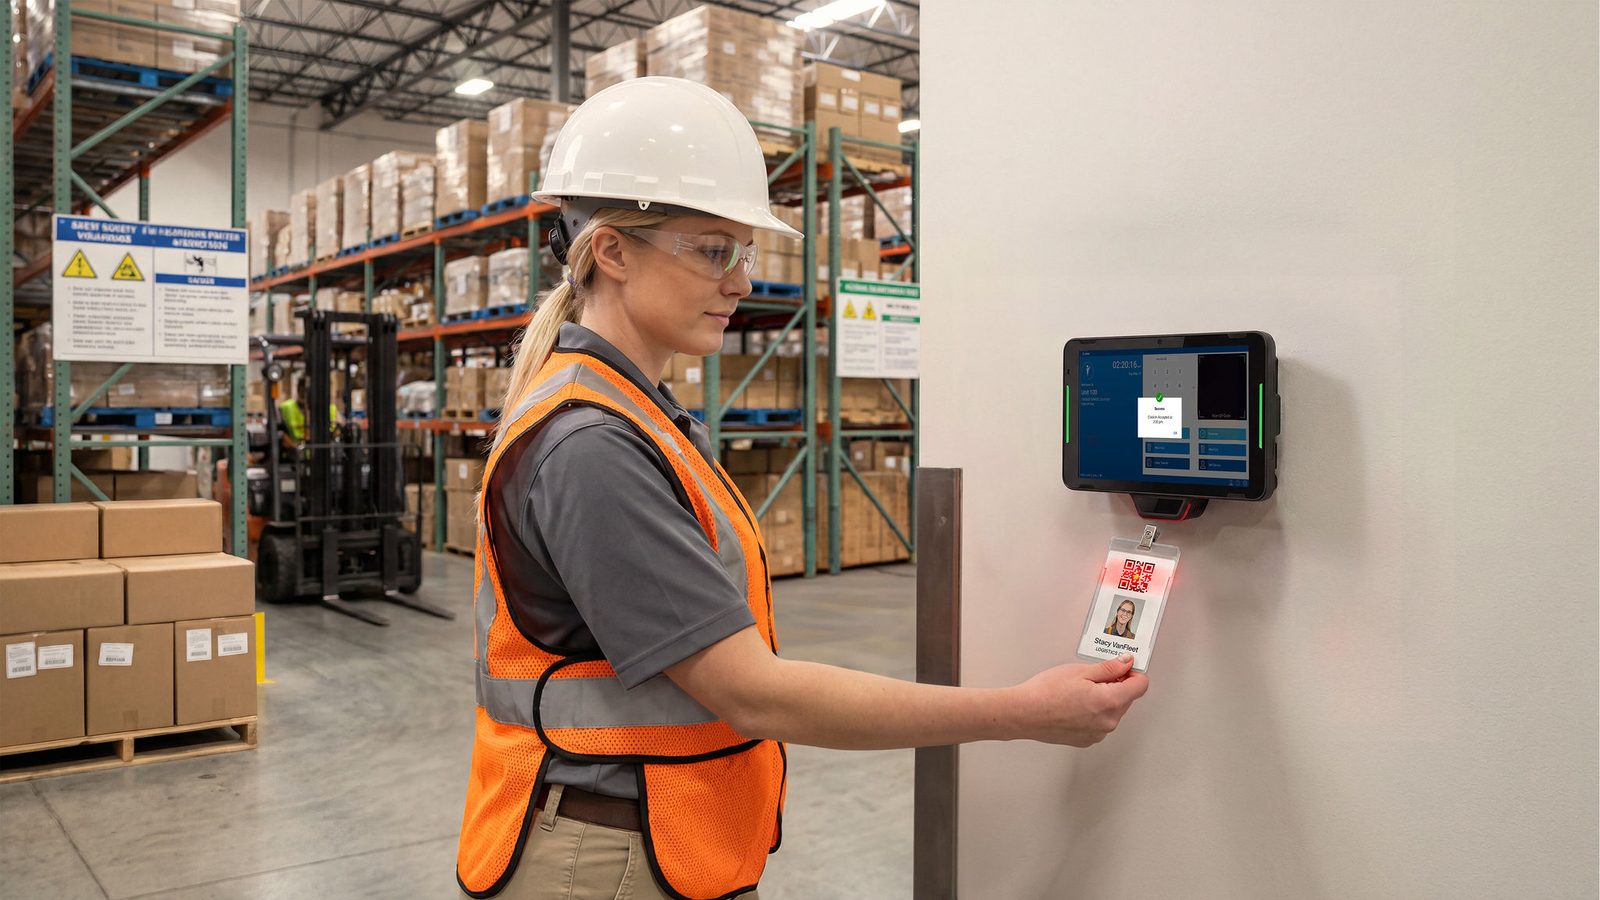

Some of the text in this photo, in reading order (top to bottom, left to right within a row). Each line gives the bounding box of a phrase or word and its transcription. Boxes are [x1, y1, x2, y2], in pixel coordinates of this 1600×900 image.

[1094, 637, 1138, 652] Stacy VanFleet
[1096, 647, 1118, 656] LOGISTICS
